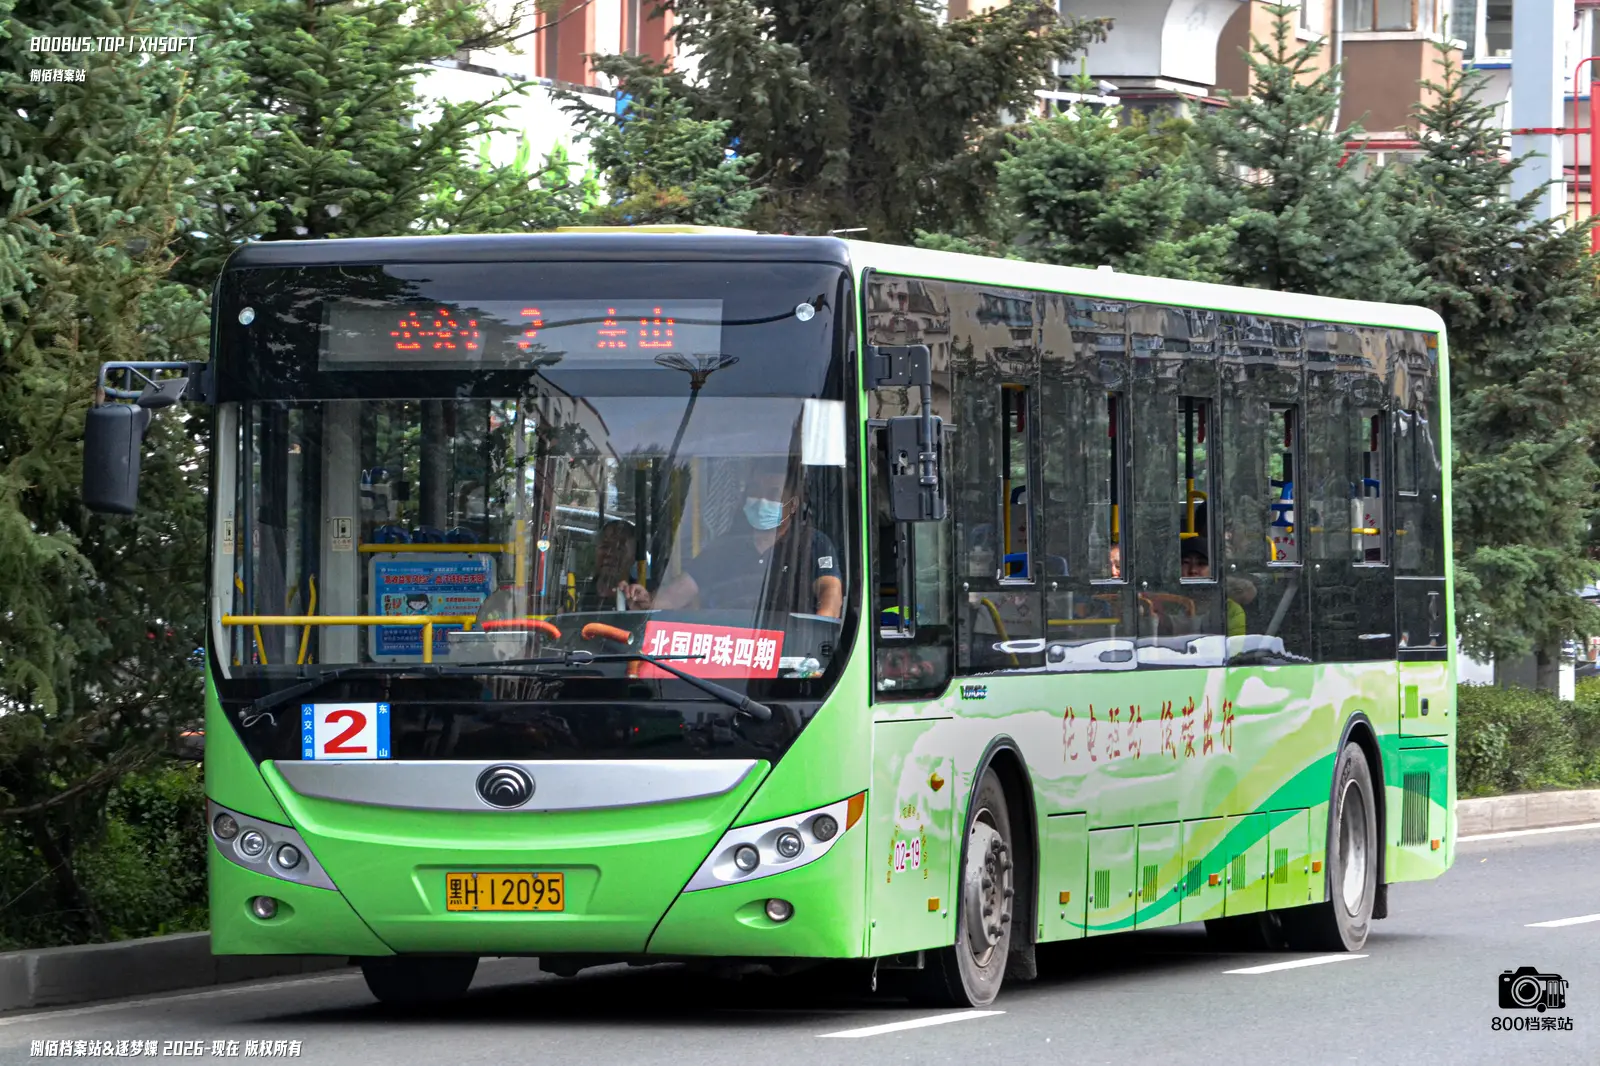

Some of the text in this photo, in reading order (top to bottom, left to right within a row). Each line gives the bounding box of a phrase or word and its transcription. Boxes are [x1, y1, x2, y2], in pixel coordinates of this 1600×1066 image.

[650, 629, 777, 671] 北国明珠四期
[303, 707, 313, 758] 公交公司
[324, 709, 368, 754] 2
[1160, 695, 1236, 760] 低碳出行
[894, 838, 921, 872] 02-19
